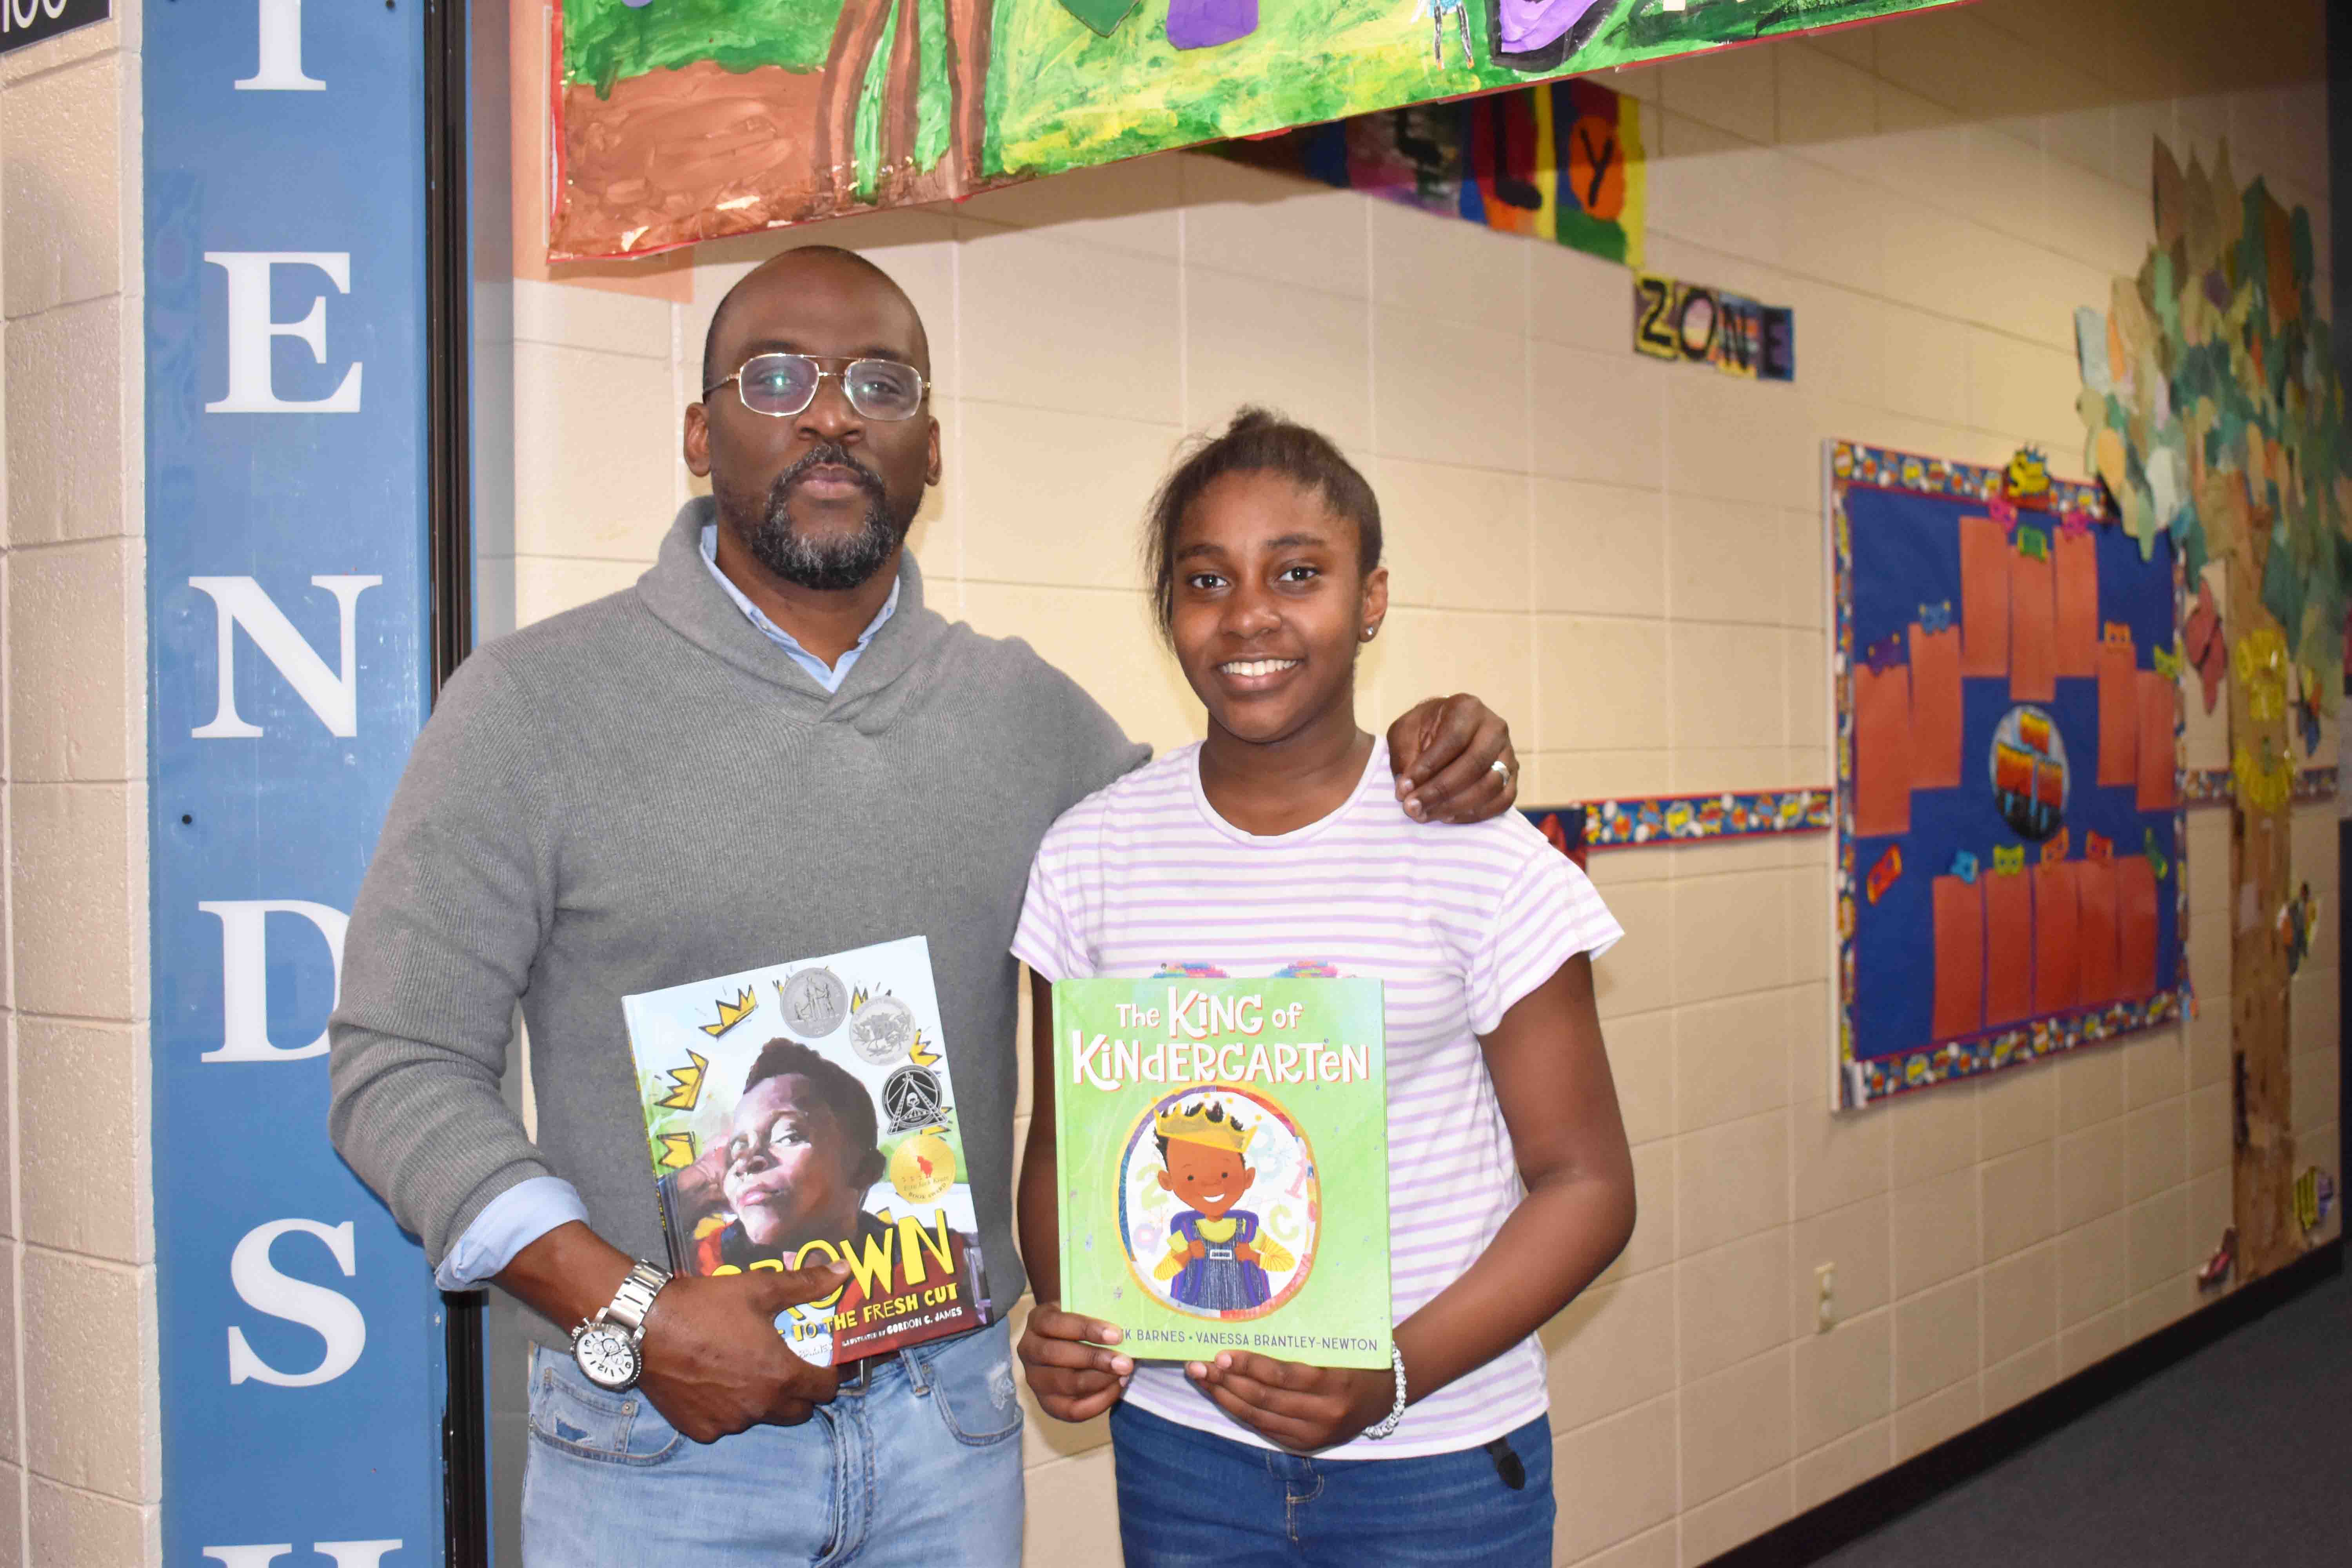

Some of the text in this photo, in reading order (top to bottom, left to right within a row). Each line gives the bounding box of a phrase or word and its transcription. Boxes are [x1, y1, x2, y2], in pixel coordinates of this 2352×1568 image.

[1642, 278, 1789, 377] ZONE
[189, 0, 403, 1568] IENDS
[1116, 1003, 1160, 1028] The
[1271, 1002, 1304, 1029] of
[712, 1209, 955, 1318] OWN
[792, 1283, 957, 1342] TO THE FRESH CUT
[886, 1317, 922, 1334] GORDON
[924, 1315, 933, 1325] C.
[935, 1307, 963, 1322] JAMES
[1137, 1329, 1185, 1343] BARNES
[1196, 1332, 1250, 1346] VANESSA
[1254, 1335, 1377, 1351] BRANTLEY-NEWTON
